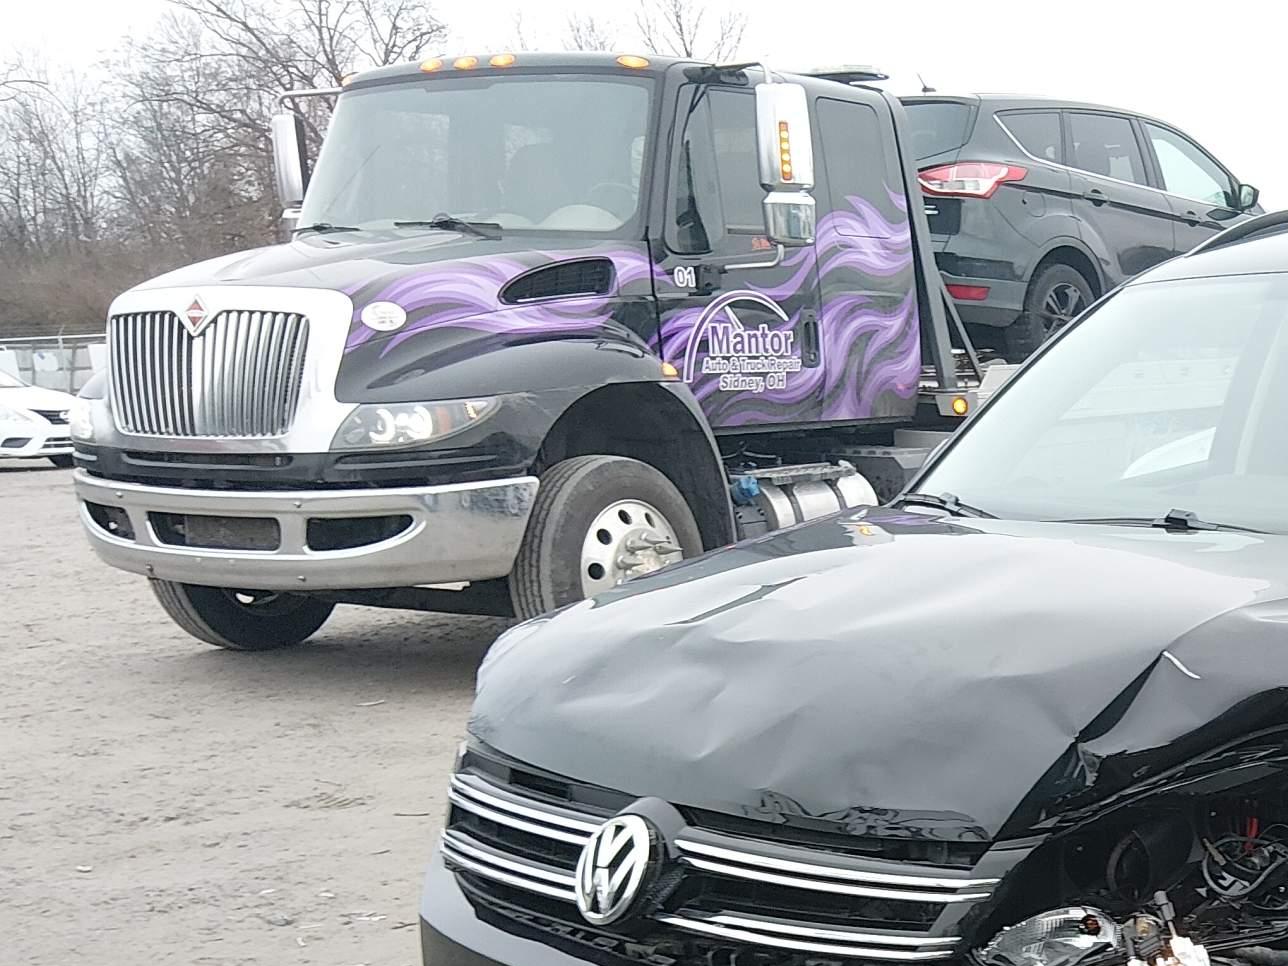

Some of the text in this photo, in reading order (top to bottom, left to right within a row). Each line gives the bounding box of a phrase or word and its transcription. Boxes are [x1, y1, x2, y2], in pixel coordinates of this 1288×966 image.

[674, 266, 696, 287] 01
[709, 324, 793, 356] Mantor
[703, 356, 801, 373] Auto & Truck Repair
[720, 373, 786, 392] Sidney, OH
